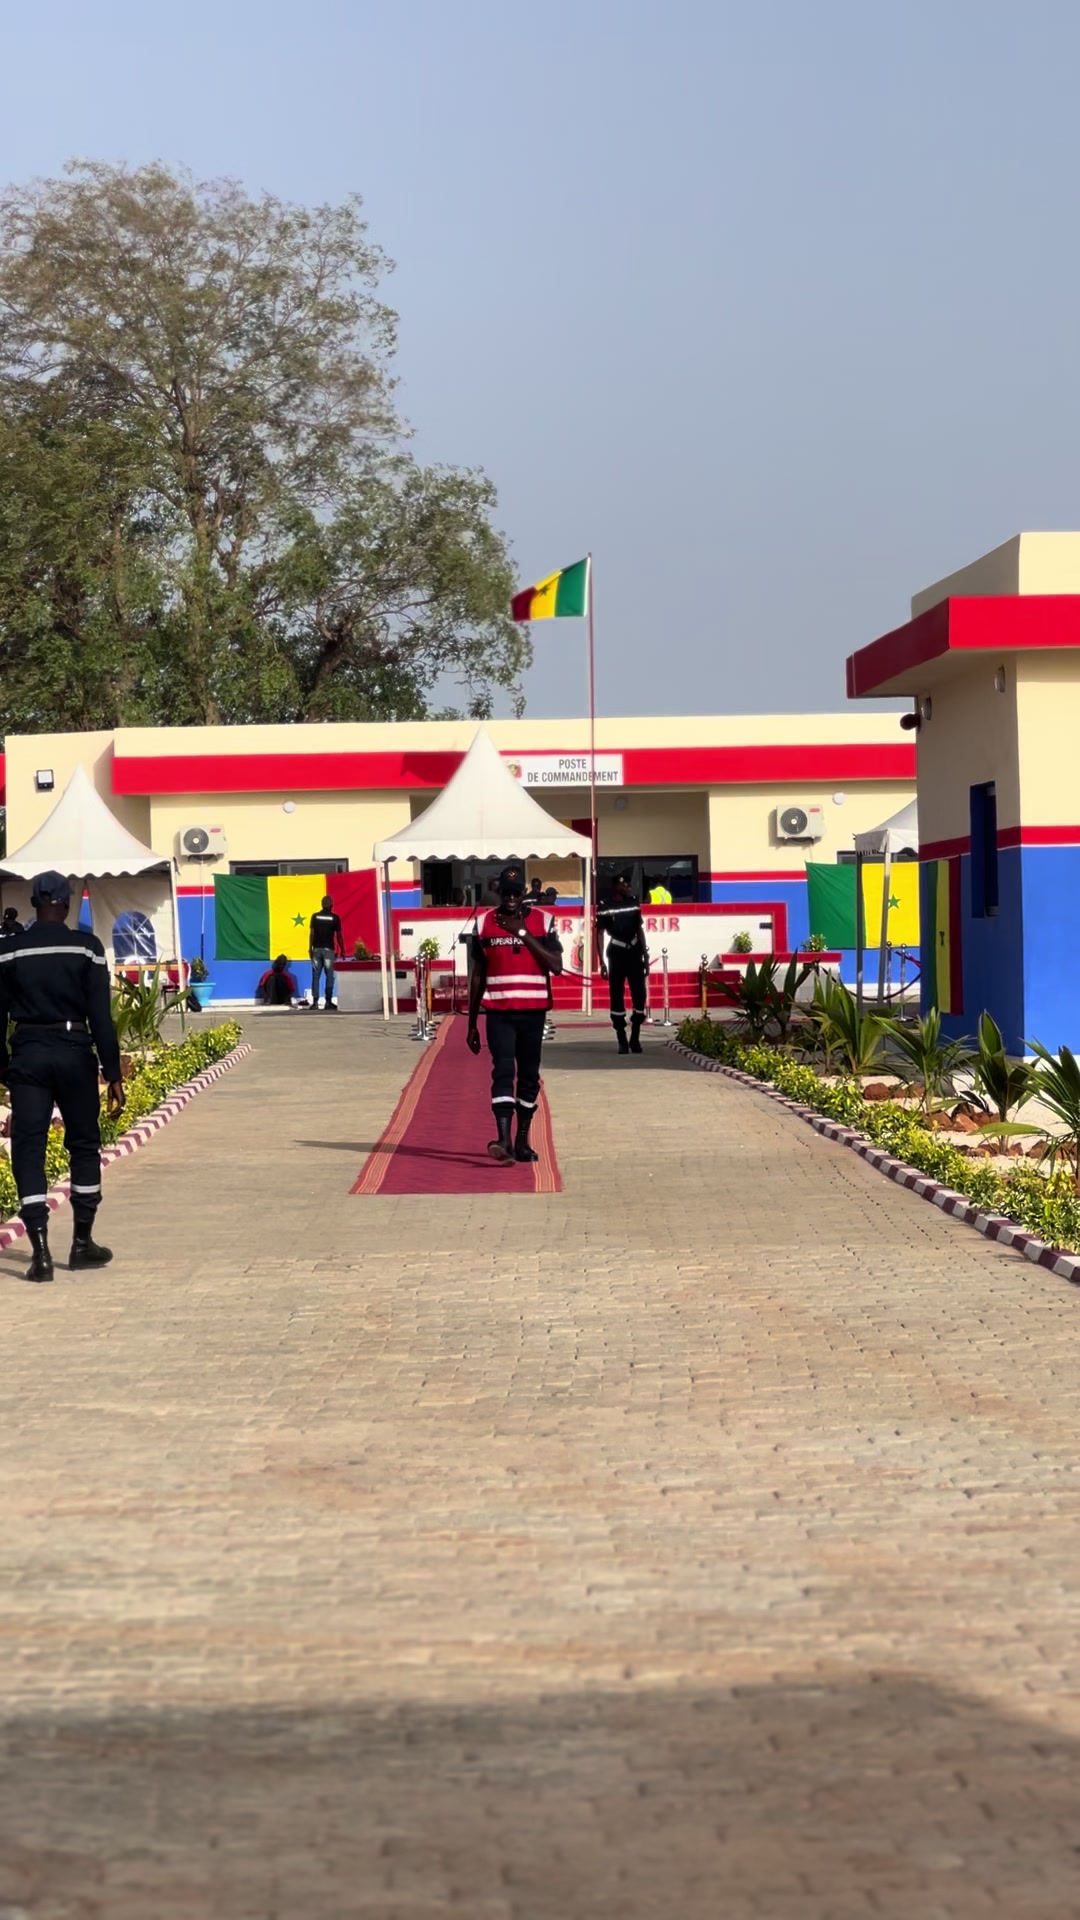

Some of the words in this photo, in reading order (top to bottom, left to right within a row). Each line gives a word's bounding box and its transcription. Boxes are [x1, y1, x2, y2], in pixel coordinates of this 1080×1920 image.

[558, 758, 587, 769] POSTE
[527, 771, 539, 783] DE
[541, 771, 618, 782] COMMANDEMENT
[645, 917, 680, 932] RIR
